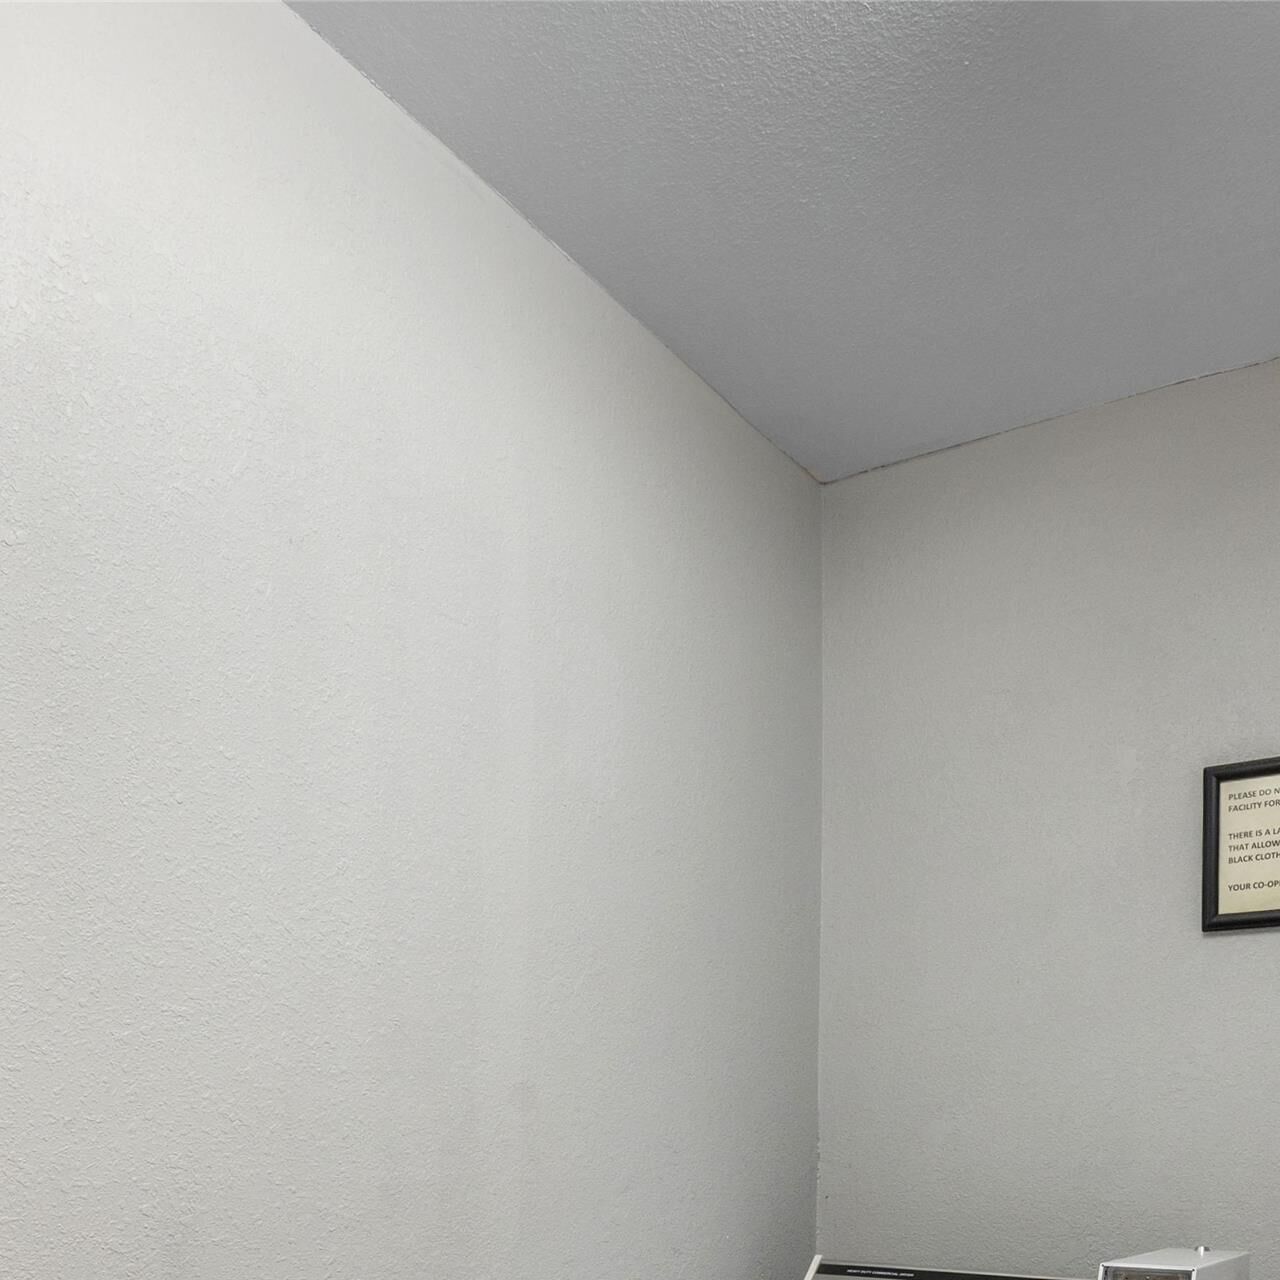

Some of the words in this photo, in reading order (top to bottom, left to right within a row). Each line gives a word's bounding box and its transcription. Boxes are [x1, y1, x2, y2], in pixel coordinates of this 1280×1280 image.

[1228, 790, 1257, 801] PLEASE
[1259, 788, 1272, 797] DO
[1228, 801, 1262, 812] FACILITY
[1264, 799, 1280, 807] FOR
[1228, 830, 1253, 840] THERE
[1255, 829, 1262, 837] IS
[1228, 843, 1249, 852] THAT
[1228, 854, 1253, 864] BLACK
[1228, 883, 1251, 892] YOUR
